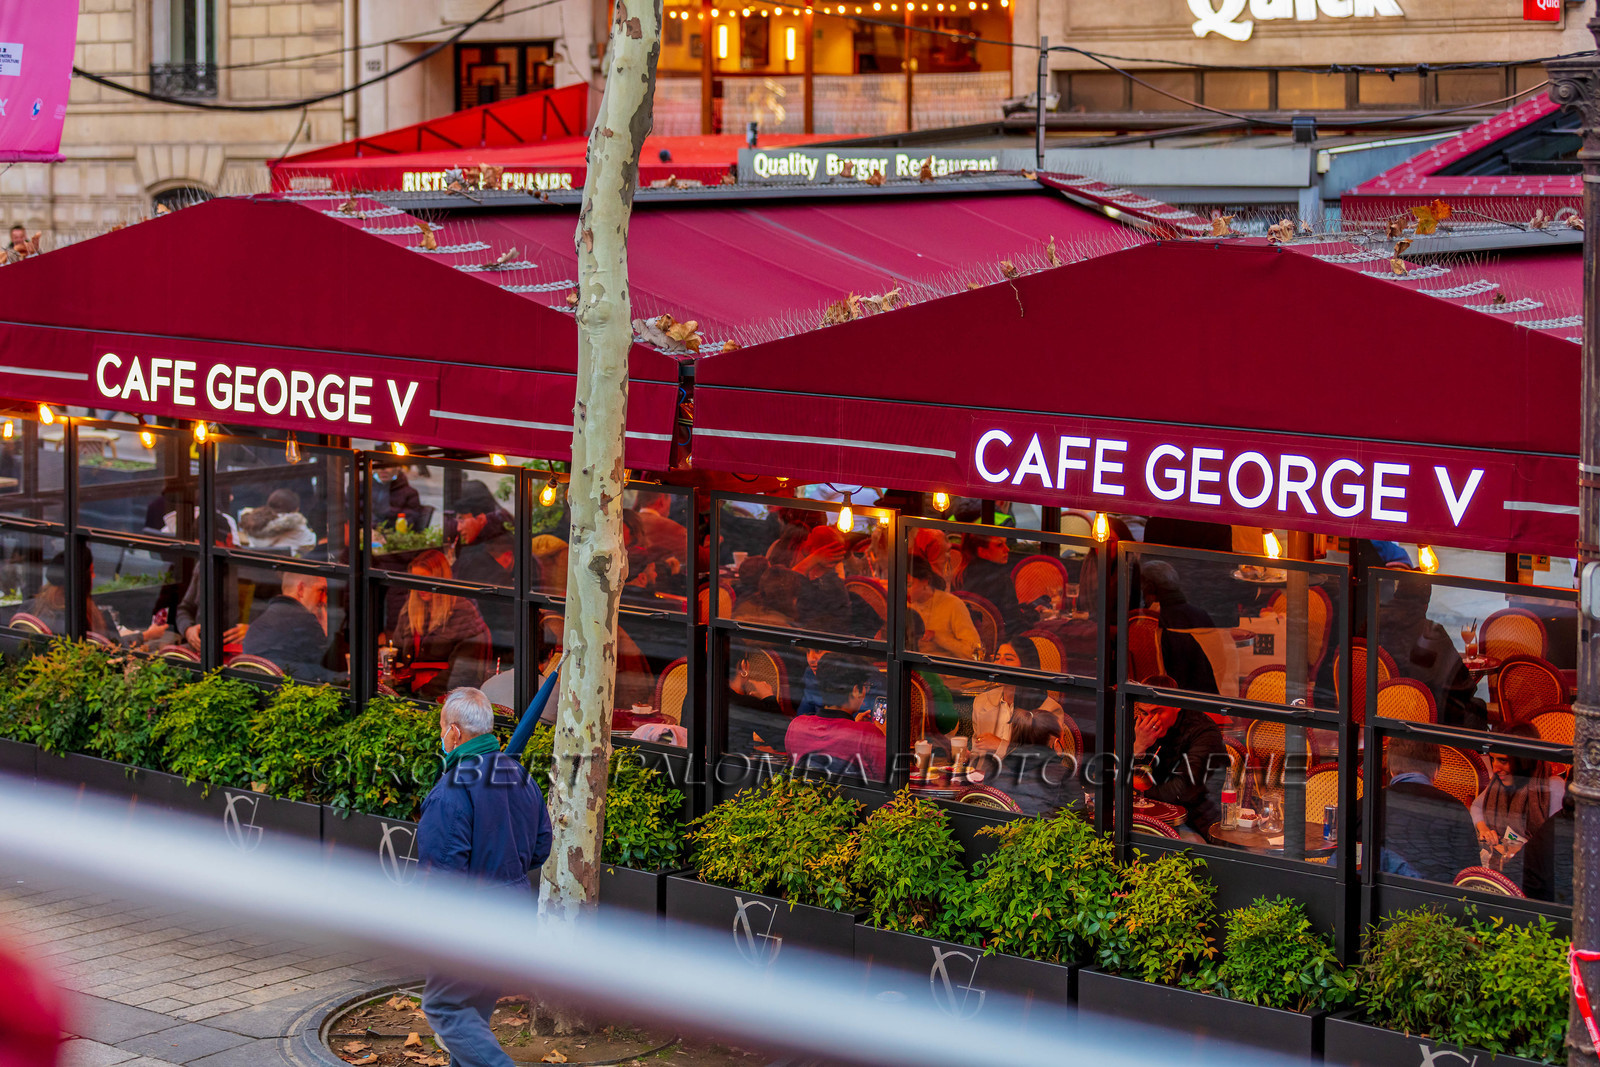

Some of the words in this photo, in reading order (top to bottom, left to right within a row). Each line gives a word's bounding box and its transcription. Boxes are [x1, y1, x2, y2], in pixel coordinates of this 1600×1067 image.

[753, 152, 819, 180] Quality
[96, 353, 197, 406] CAFE
[206, 363, 374, 425] GEORGE
[386, 379, 419, 427] V
[975, 429, 1129, 496] CAFE
[1145, 443, 1410, 523] GEORGE
[1434, 466, 1485, 527] V
